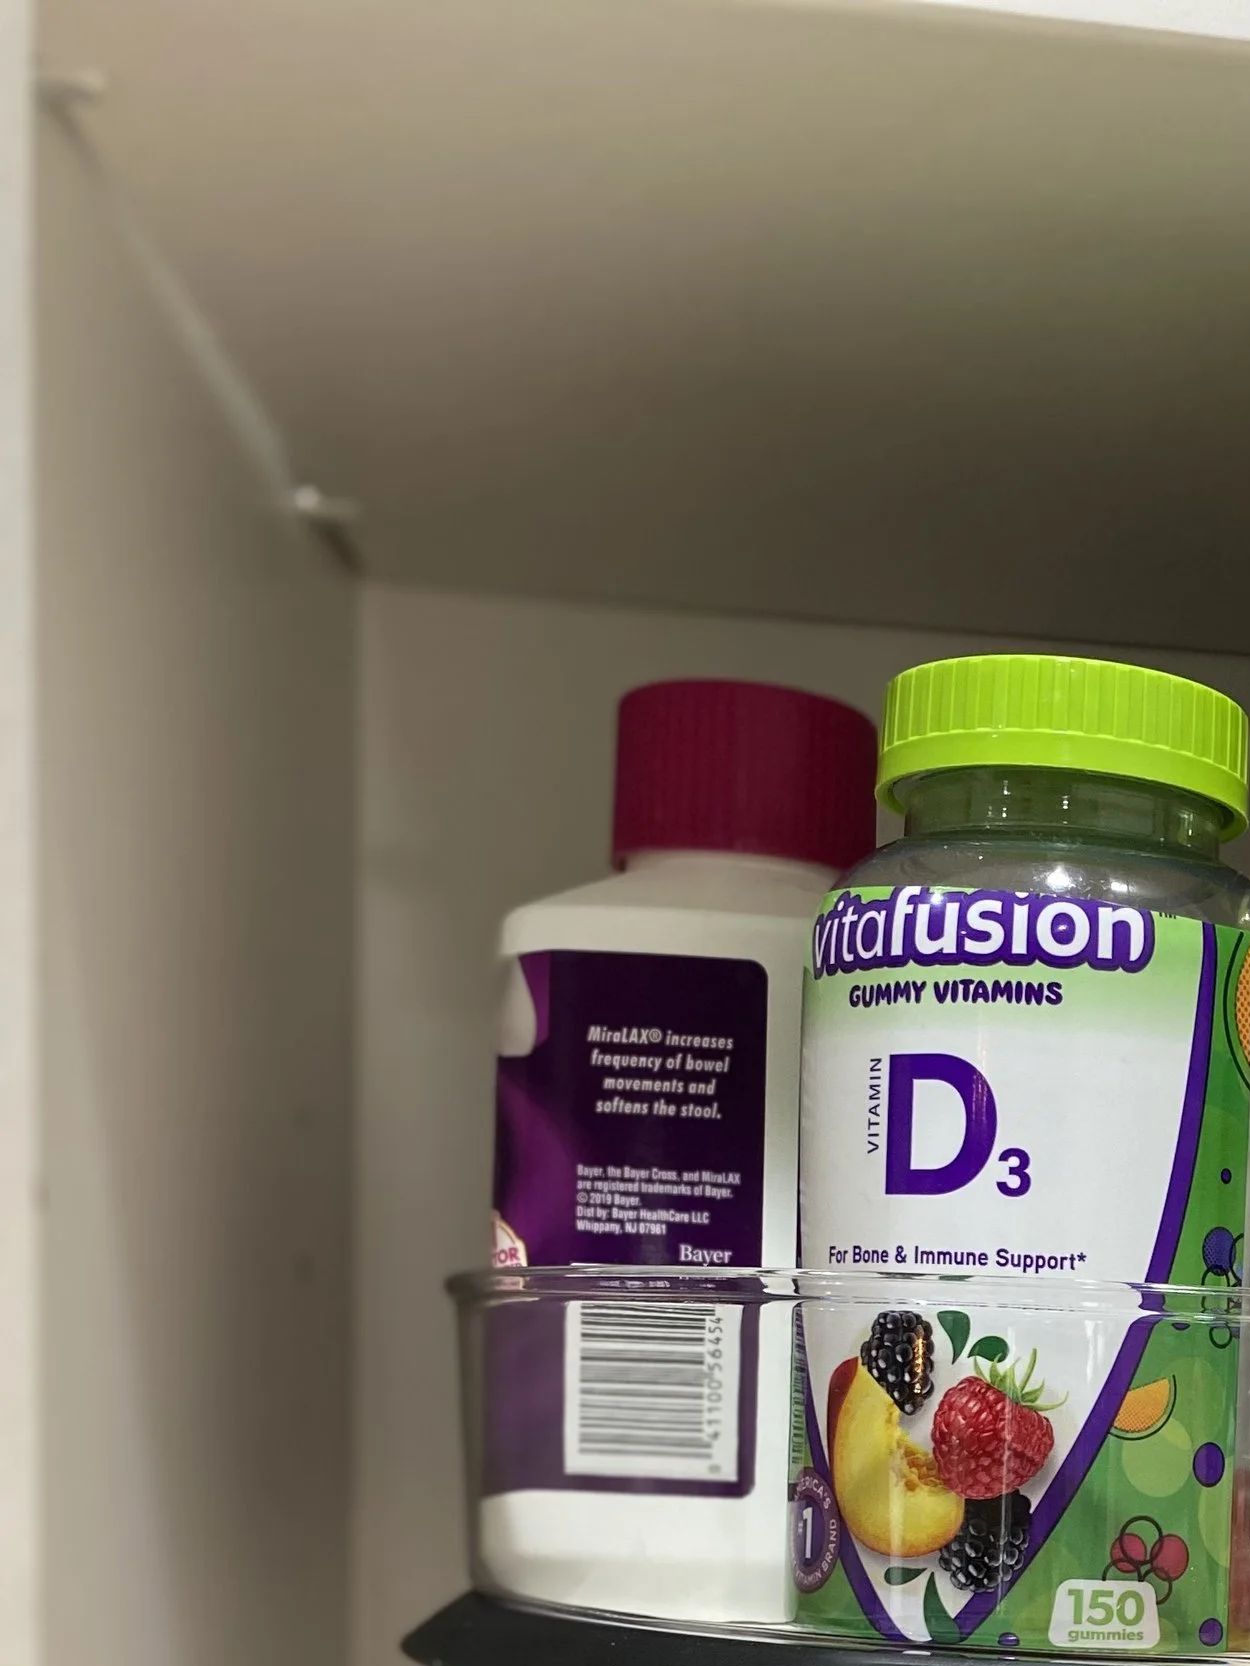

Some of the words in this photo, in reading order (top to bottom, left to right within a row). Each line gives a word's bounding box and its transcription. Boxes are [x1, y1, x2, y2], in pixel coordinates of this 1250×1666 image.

[813, 887, 1145, 969] vitafusion
[849, 980, 926, 1007] GUMMY
[934, 980, 1063, 1005] VITAMINS
[665, 1030, 733, 1049] increases
[591, 1049, 661, 1072] frequency
[666, 1053, 682, 1069] of
[686, 1054, 730, 1072] bowel
[604, 1077, 684, 1093] movements
[688, 1079, 716, 1095] and
[596, 1097, 648, 1114] softens
[653, 1098, 676, 1115] the
[681, 1103, 721, 1119] stool.
[867, 1058, 882, 1154] VITAMIN
[607, 1166, 621, 1177] the
[624, 1167, 649, 1180] Bayer
[683, 1171, 699, 1182] and
[702, 1170, 740, 1184] MiraLAX
[577, 1181, 591, 1190] are
[594, 1181, 639, 1193] registered
[641, 1183, 691, 1195] trademarks
[694, 1185, 703, 1196] of
[705, 1185, 733, 1200] Bayer.
[612, 1208, 637, 1220] Bayer
[640, 1209, 689, 1222] HealthCare
[692, 1212, 710, 1224] LLC
[577, 1220, 623, 1234] Whippany,
[625, 1223, 637, 1234] NJ
[679, 1244, 732, 1267] Bayer
[829, 1247, 848, 1264] For
[853, 1246, 888, 1265] Bone
[895, 1247, 907, 1264] &
[914, 1247, 988, 1267] Immune
[822, 1519, 837, 1571] BRAND
[1067, 1589, 1145, 1625] 150
[1068, 1628, 1144, 1643] gummies
